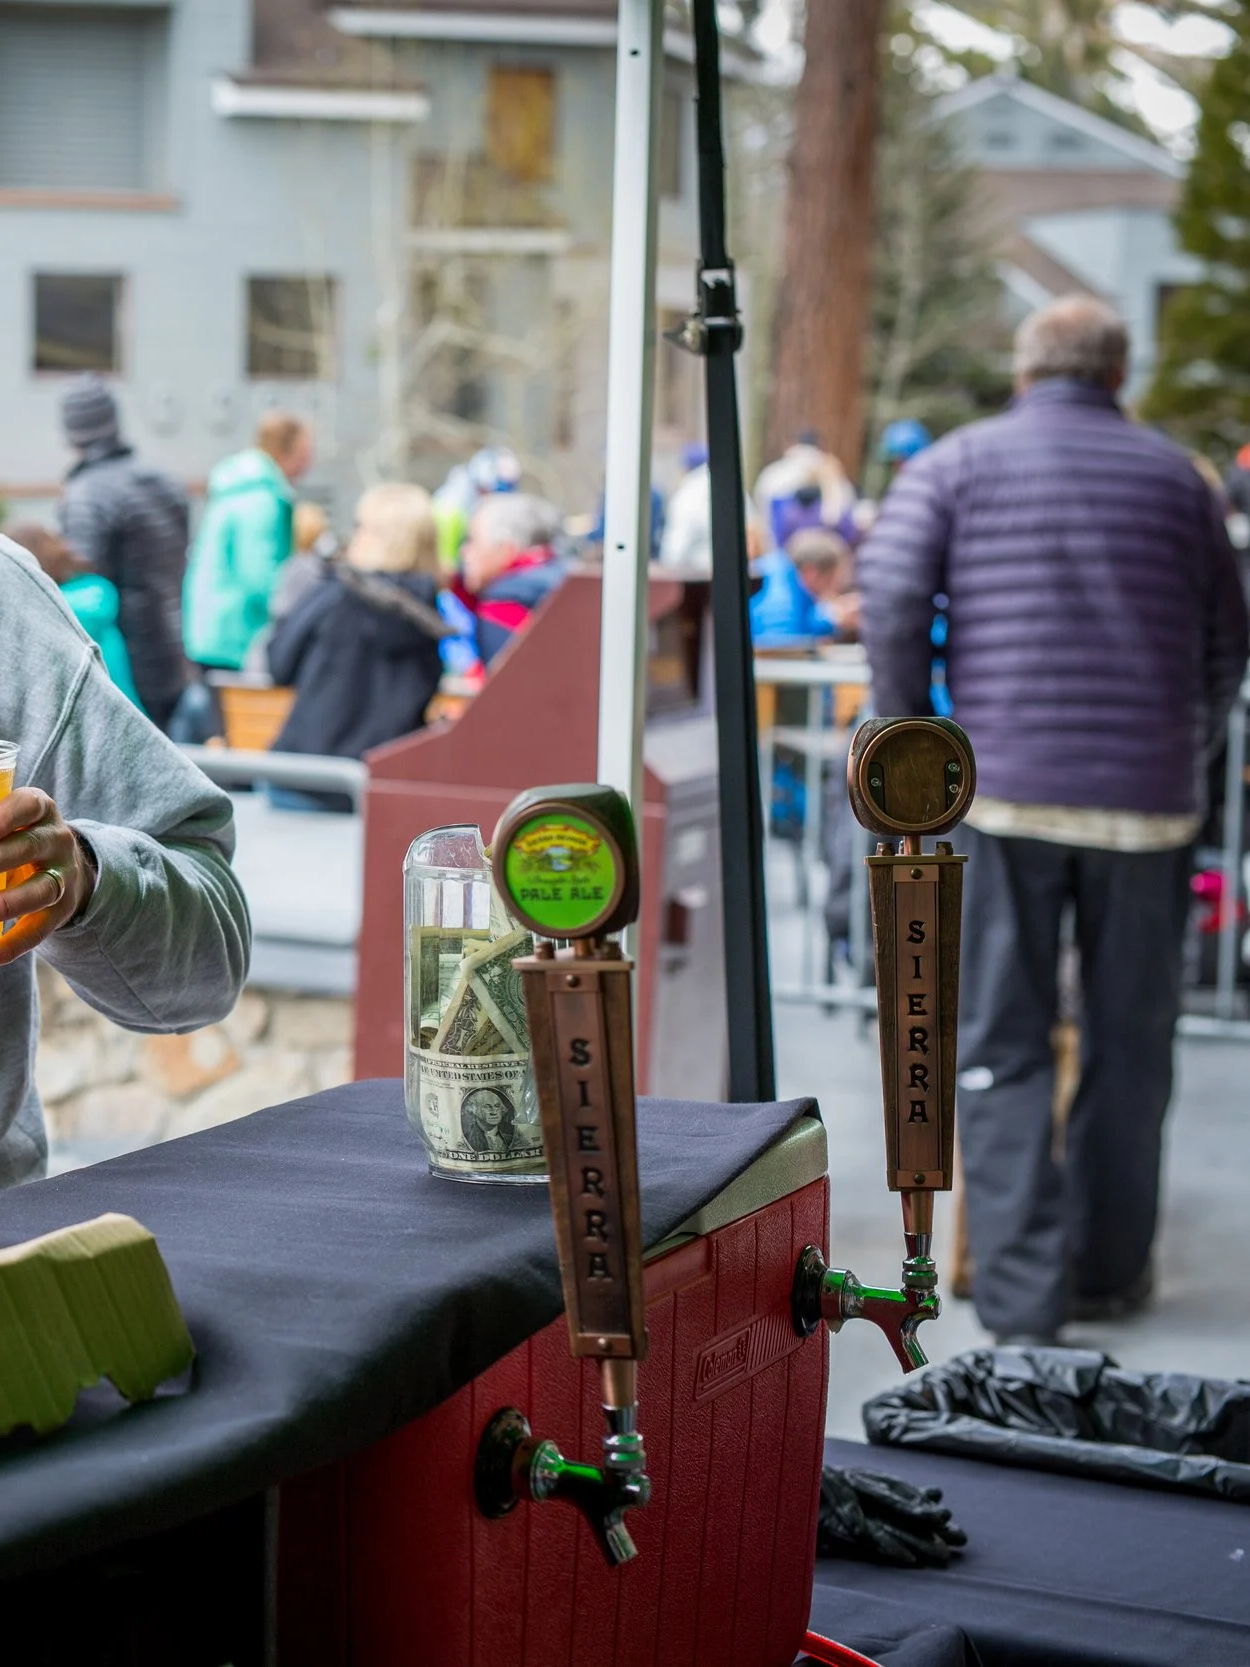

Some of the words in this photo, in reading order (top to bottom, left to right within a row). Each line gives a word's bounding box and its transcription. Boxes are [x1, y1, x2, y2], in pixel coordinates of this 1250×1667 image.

[520, 887, 563, 901] PALE
[571, 886, 604, 901] ALE
[906, 920, 931, 1125] SIERRA
[461, 1070, 503, 1081] STATES
[504, 1069, 519, 1080] OF
[449, 1150, 476, 1161] ONE
[569, 1038, 613, 1282] SIERRA
